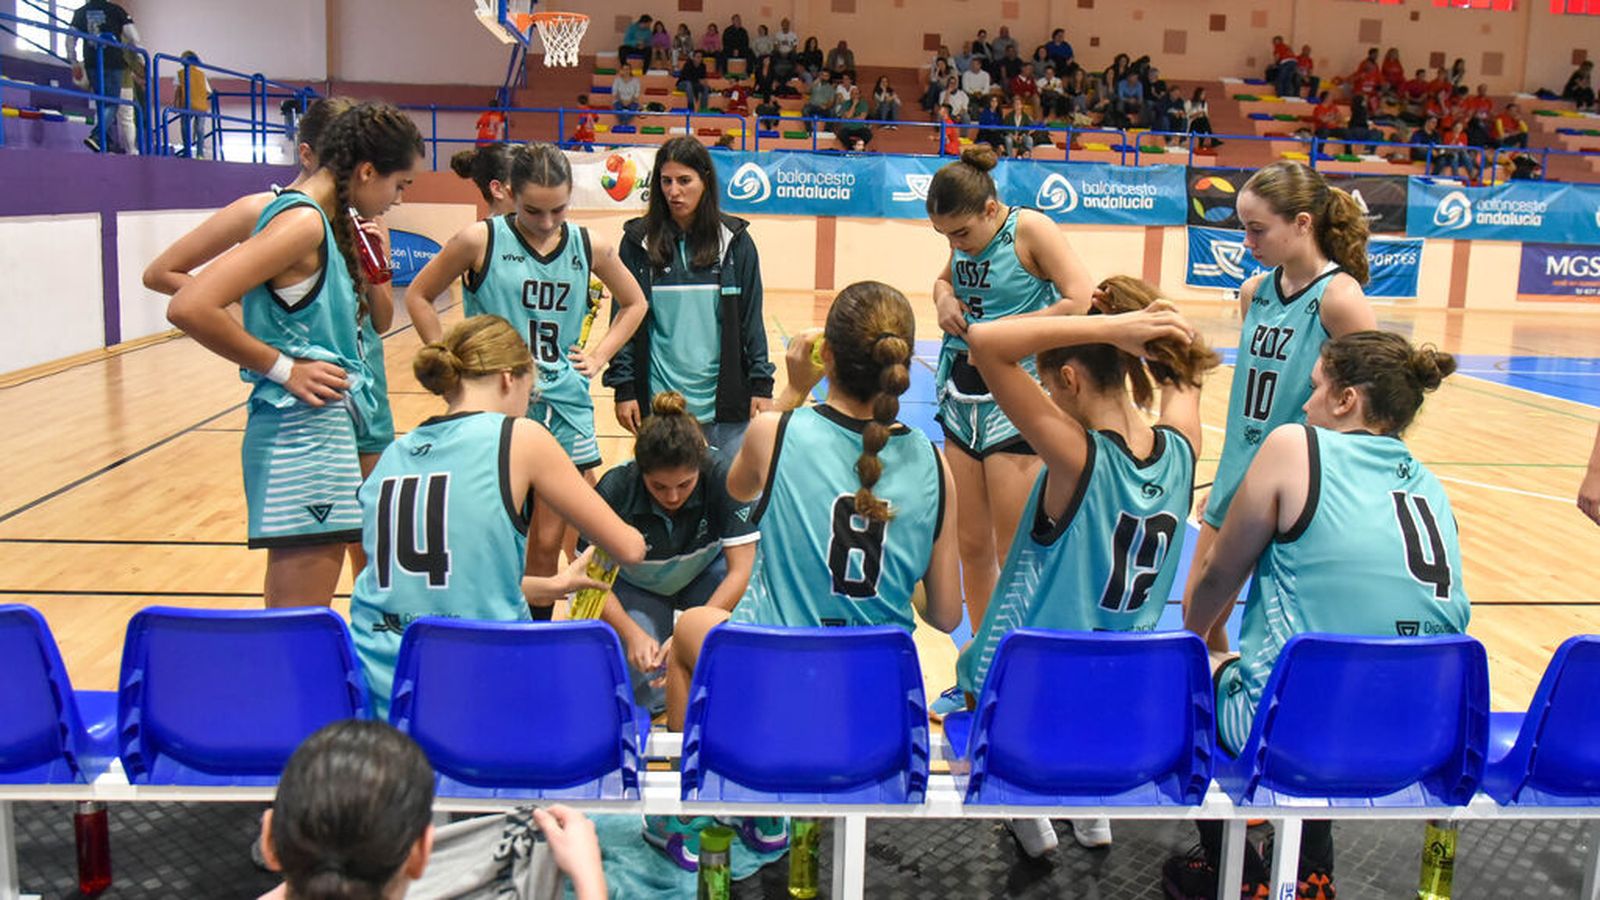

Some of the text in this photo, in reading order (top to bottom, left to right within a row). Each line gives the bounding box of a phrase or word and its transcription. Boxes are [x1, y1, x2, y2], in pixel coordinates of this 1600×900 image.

[777, 168, 855, 186] baloncesto
[1082, 180, 1157, 196] baloncesto
[955, 259, 991, 289] CDZ
[1546, 255, 1600, 277] MGS
[521, 278, 571, 312] CDZ
[528, 318, 561, 364] 13
[1250, 324, 1295, 361] CDZ
[1243, 367, 1279, 423] 10
[376, 471, 452, 592] 14
[826, 492, 891, 600] 8
[1389, 489, 1453, 601] 4
[1098, 510, 1179, 613] 12
